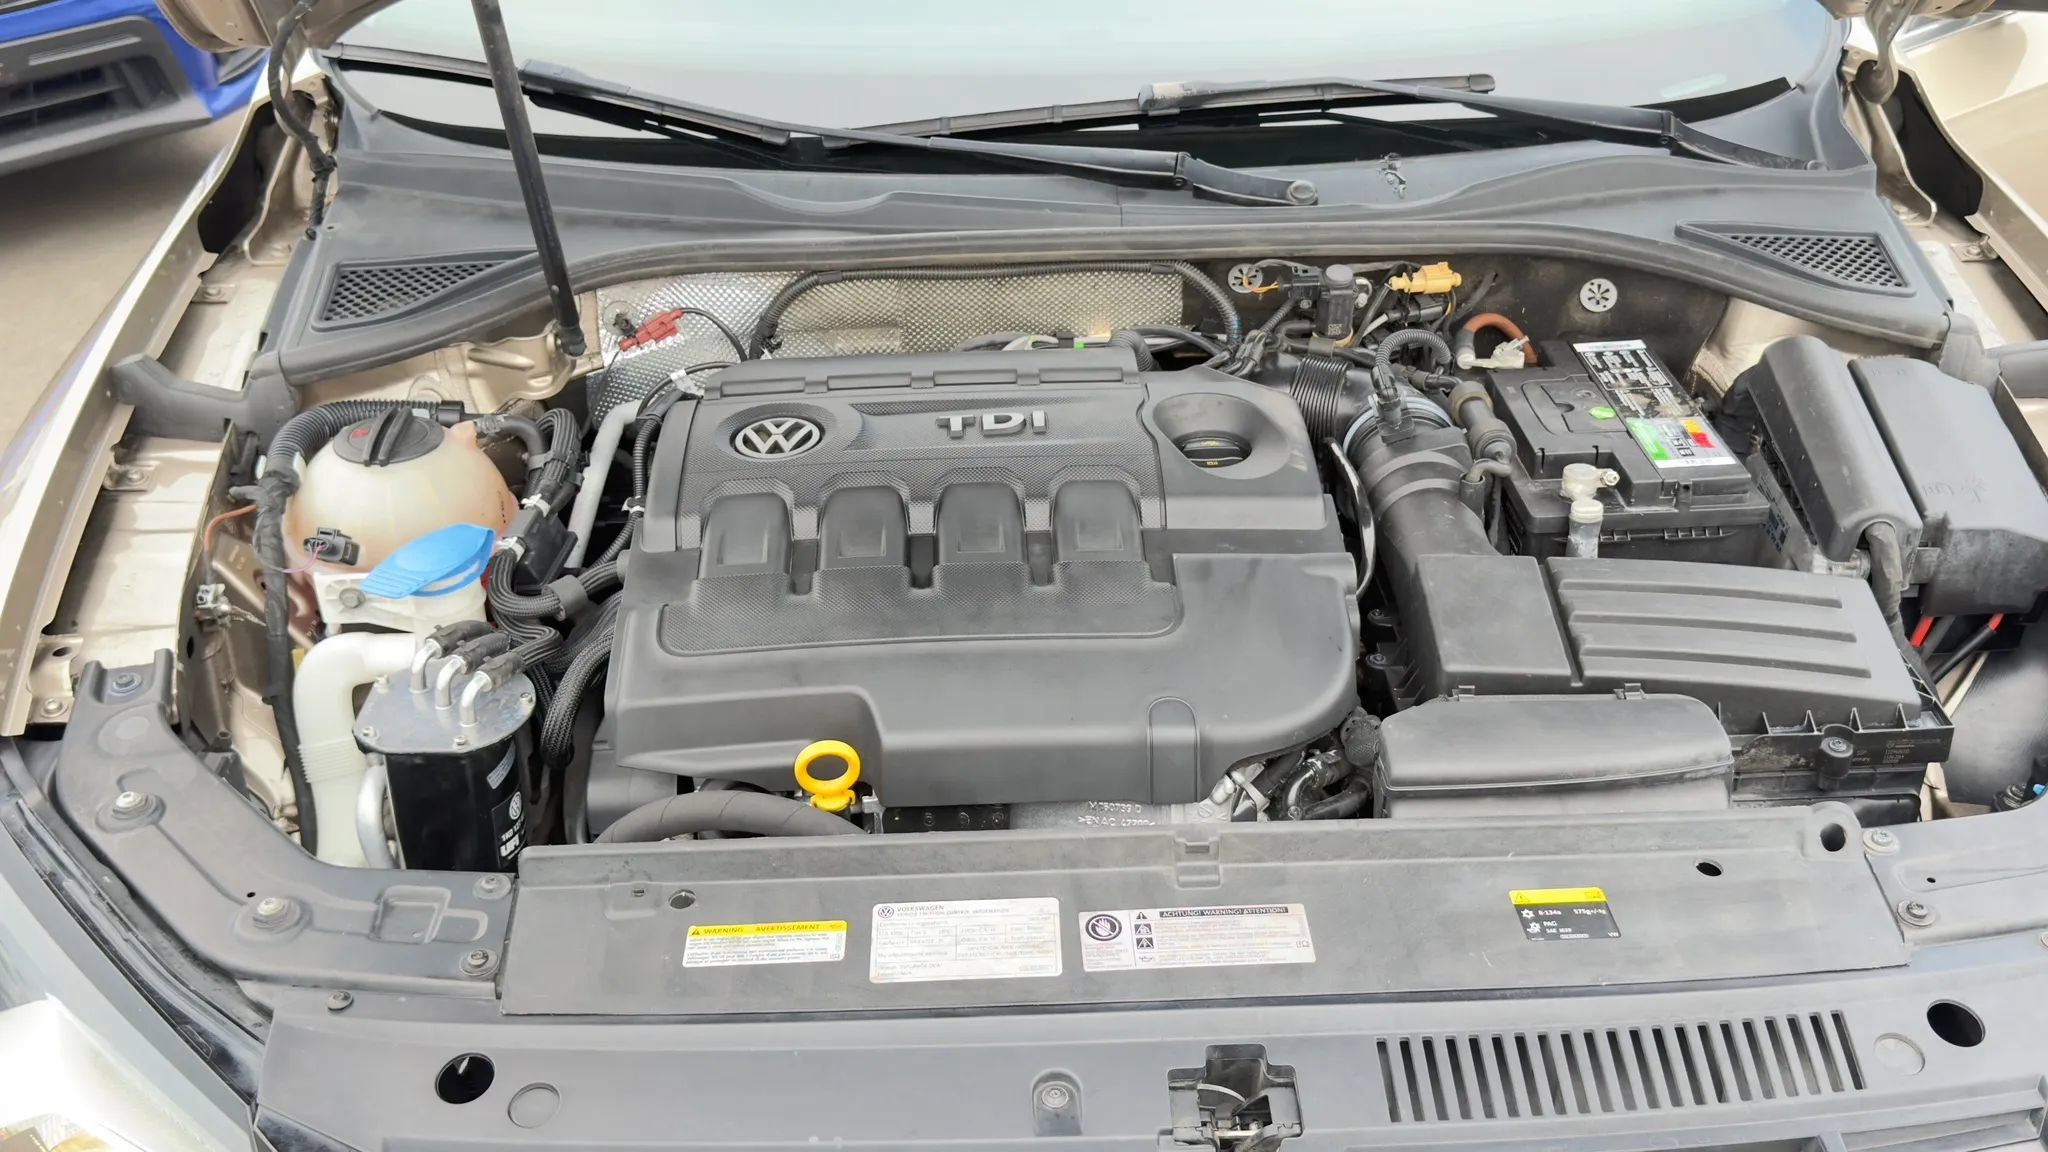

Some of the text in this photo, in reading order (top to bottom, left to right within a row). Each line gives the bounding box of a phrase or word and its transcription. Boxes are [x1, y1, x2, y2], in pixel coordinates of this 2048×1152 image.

[935, 410, 1049, 439] TDI
[896, 904, 945, 913] VOLKSWAGEN
[1203, 908, 1241, 916] WARNING!
[704, 924, 820, 935] WARNING AVERTISSEMENT
